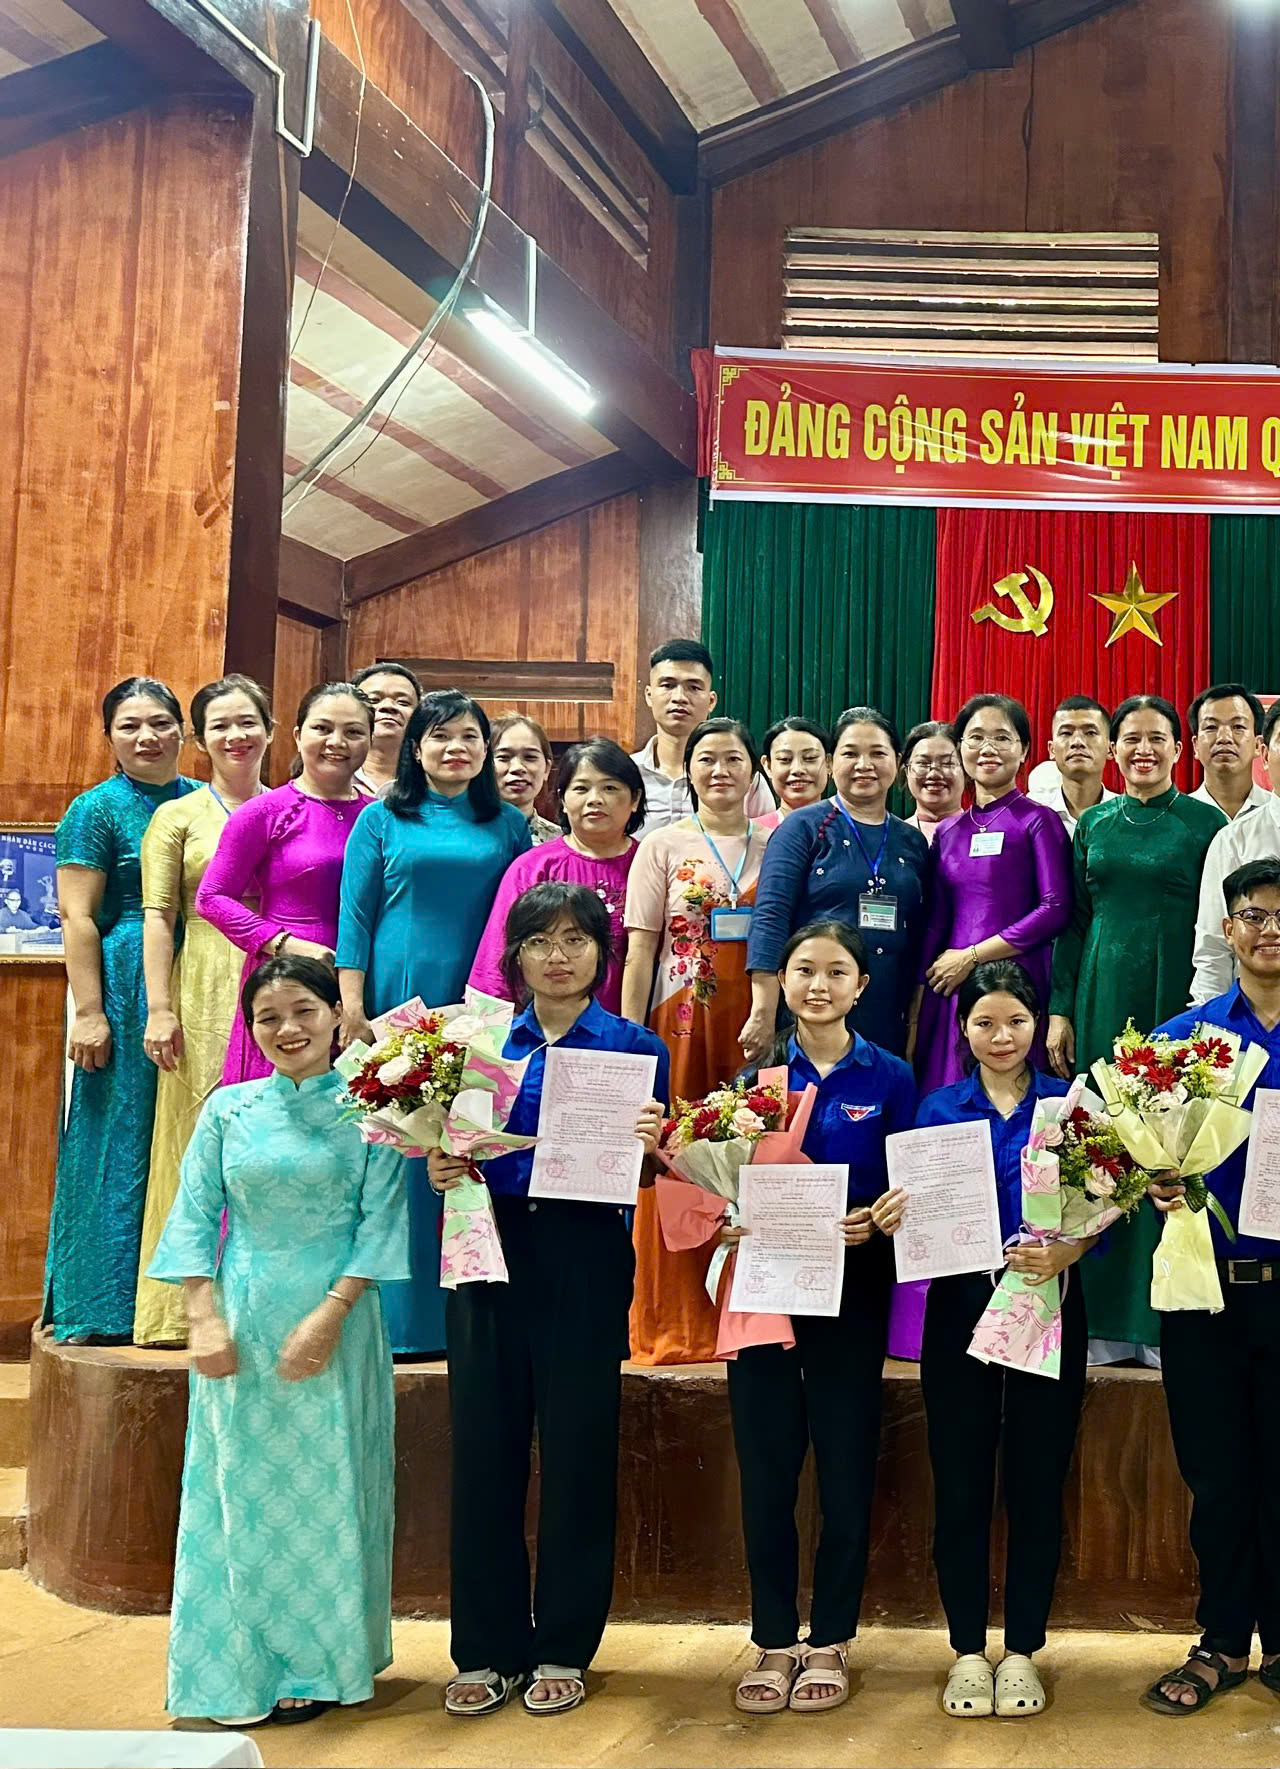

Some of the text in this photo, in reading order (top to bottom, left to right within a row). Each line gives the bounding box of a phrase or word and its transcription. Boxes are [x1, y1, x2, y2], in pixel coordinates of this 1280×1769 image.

[744, 382, 851, 458] ĐẢNG
[863, 394, 967, 474] CỘNG
[980, 391, 1058, 466] SẢN
[1070, 401, 1150, 481] VIỆT
[1161, 415, 1248, 471] NAM
